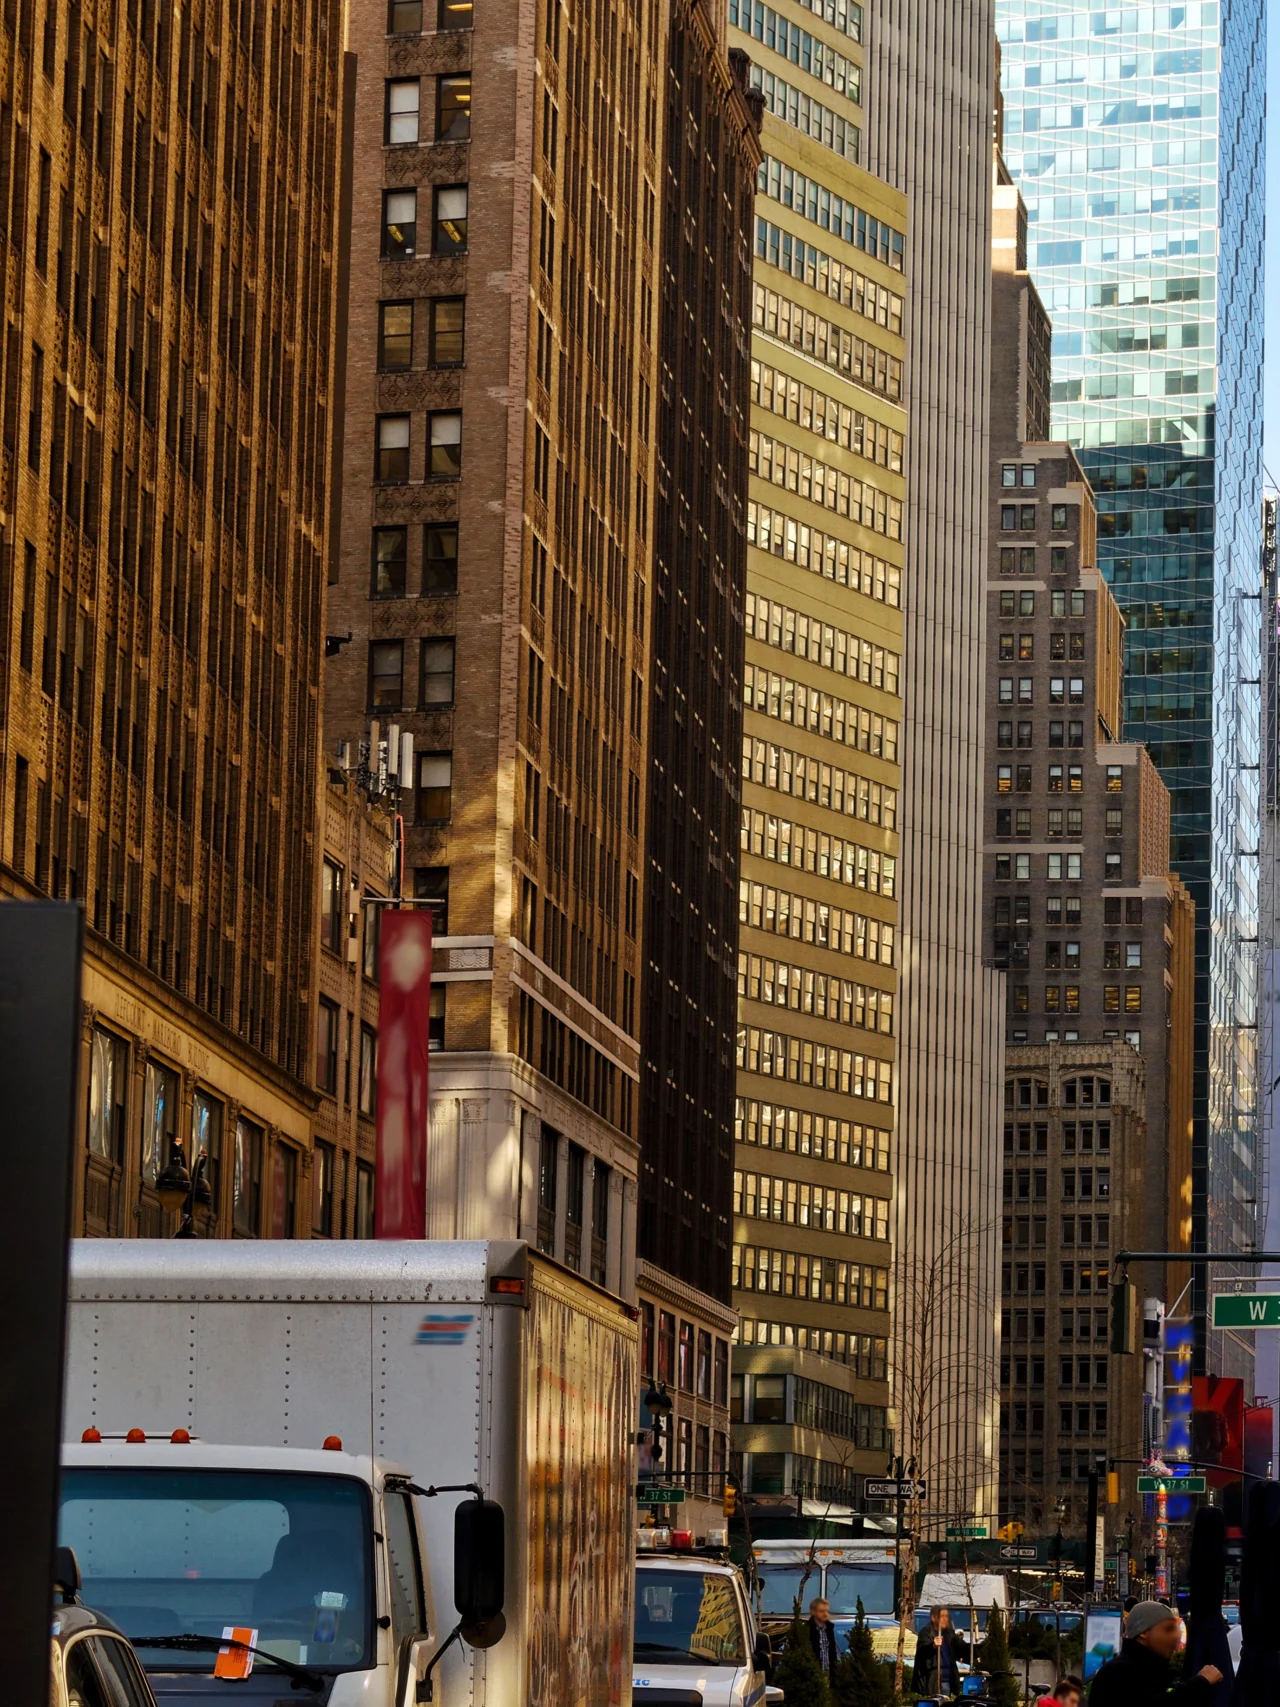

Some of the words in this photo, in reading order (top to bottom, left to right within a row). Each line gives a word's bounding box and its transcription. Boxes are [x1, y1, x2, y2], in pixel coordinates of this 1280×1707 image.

[1249, 1301, 1267, 1321] W
[871, 1485, 889, 1493] ONE
[1167, 1480, 1177, 1490] 37
[1180, 1480, 1190, 1490] St
[650, 1492, 660, 1501] 37
[663, 1492, 672, 1501] St
